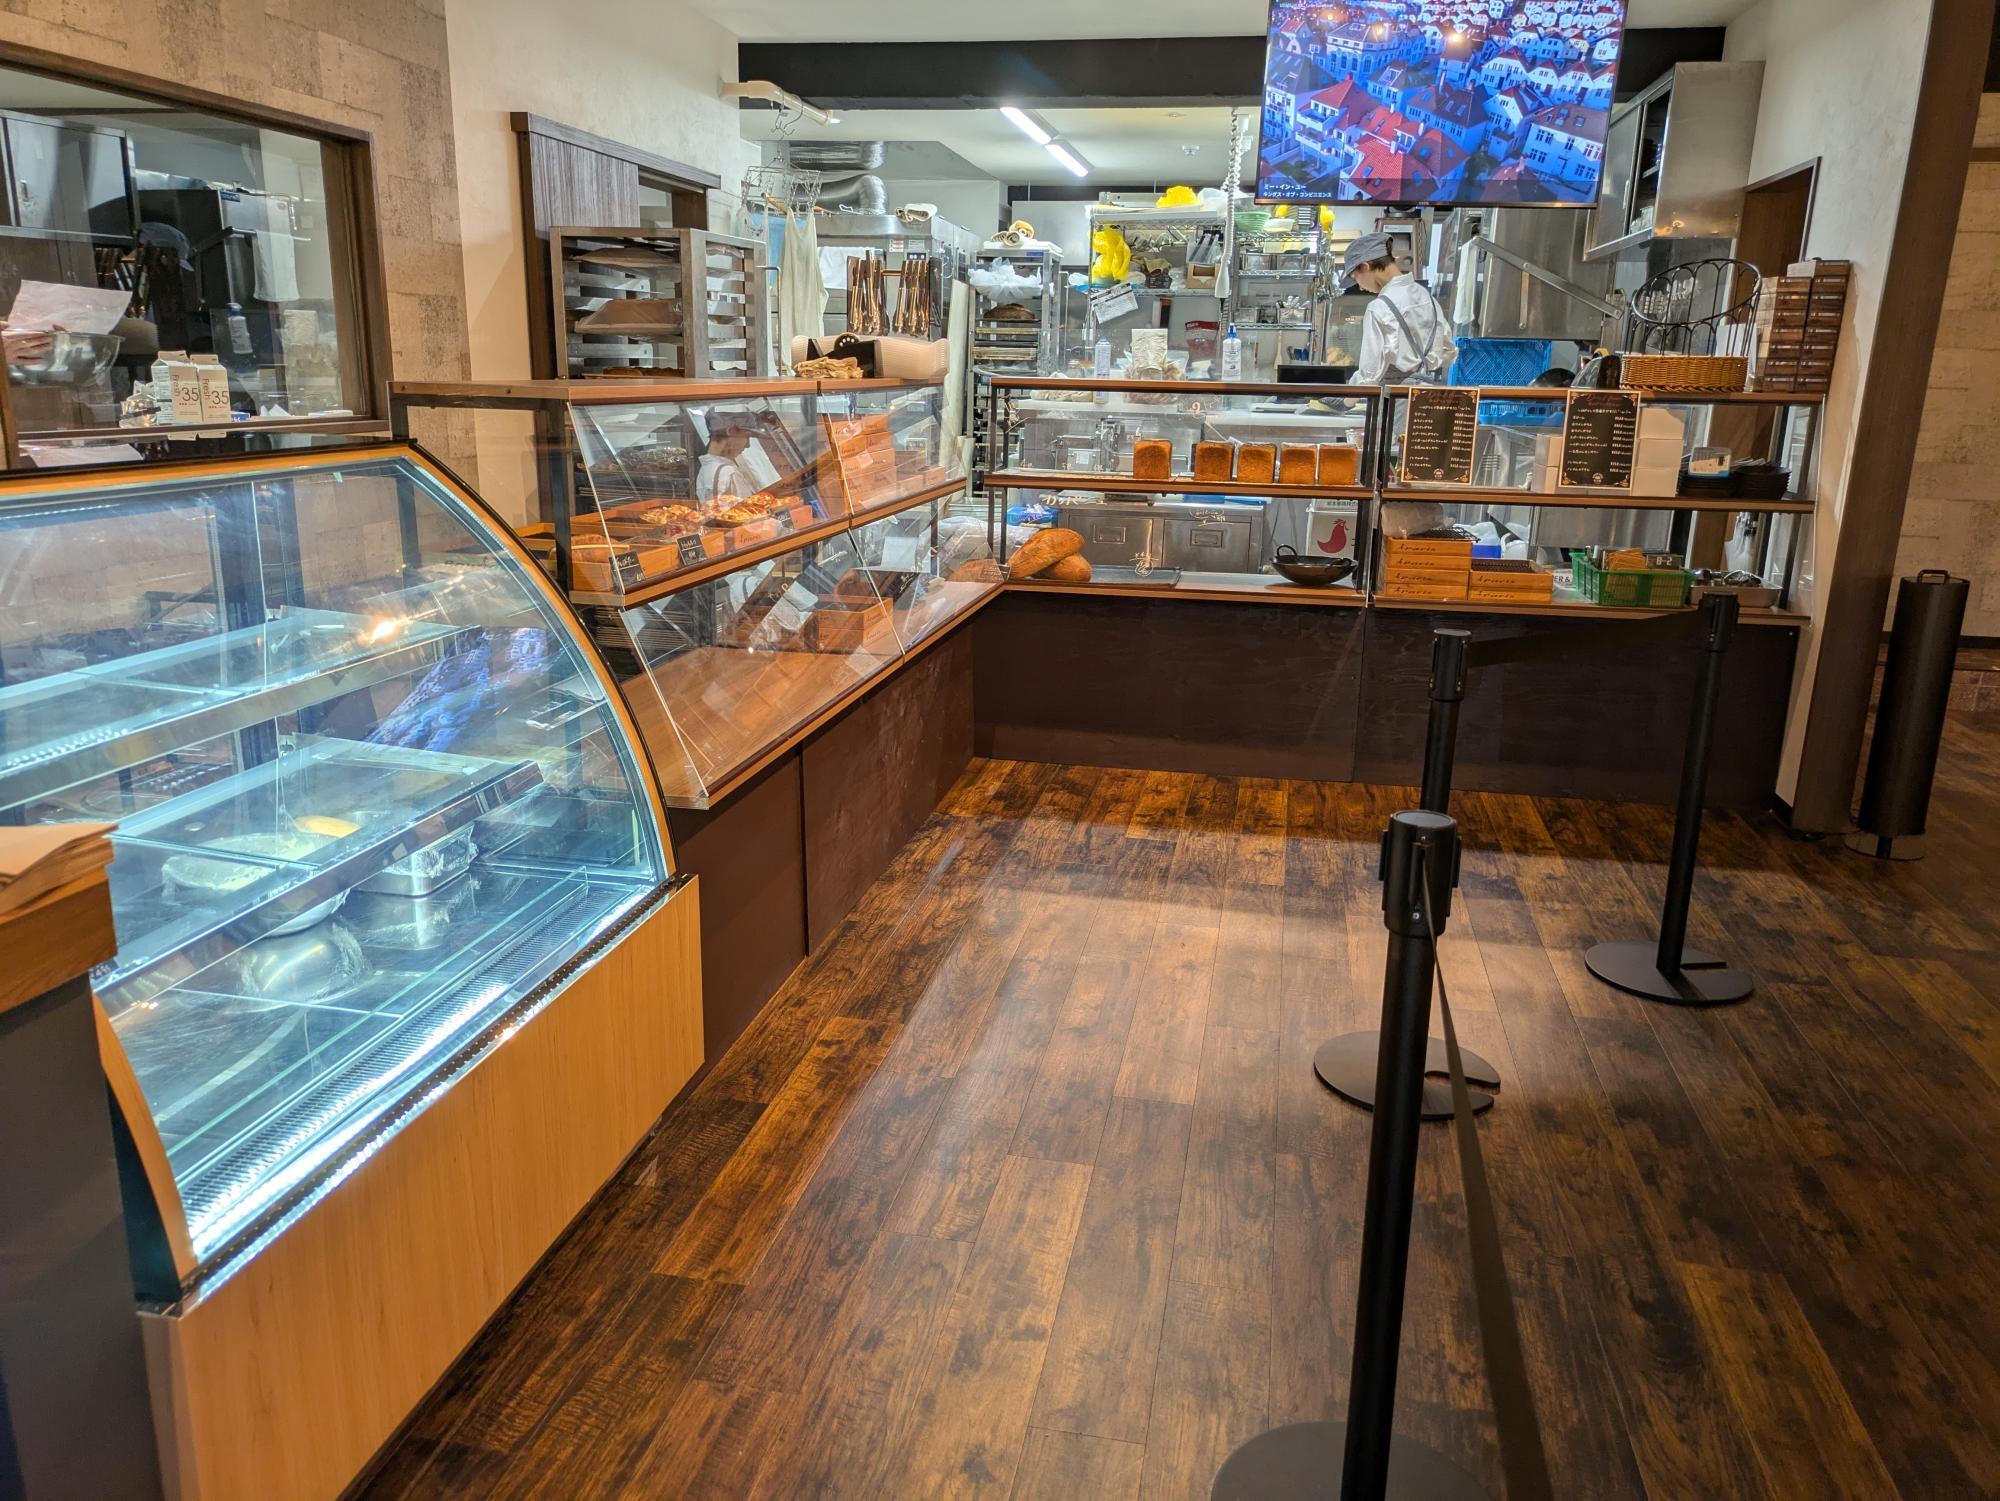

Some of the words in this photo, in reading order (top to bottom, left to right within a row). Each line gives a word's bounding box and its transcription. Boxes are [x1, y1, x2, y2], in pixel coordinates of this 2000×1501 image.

[172, 374, 180, 396] Fresh
[181, 387, 199, 401] 35
[202, 378, 211, 399] Fresh
[211, 390, 229, 405] 35
